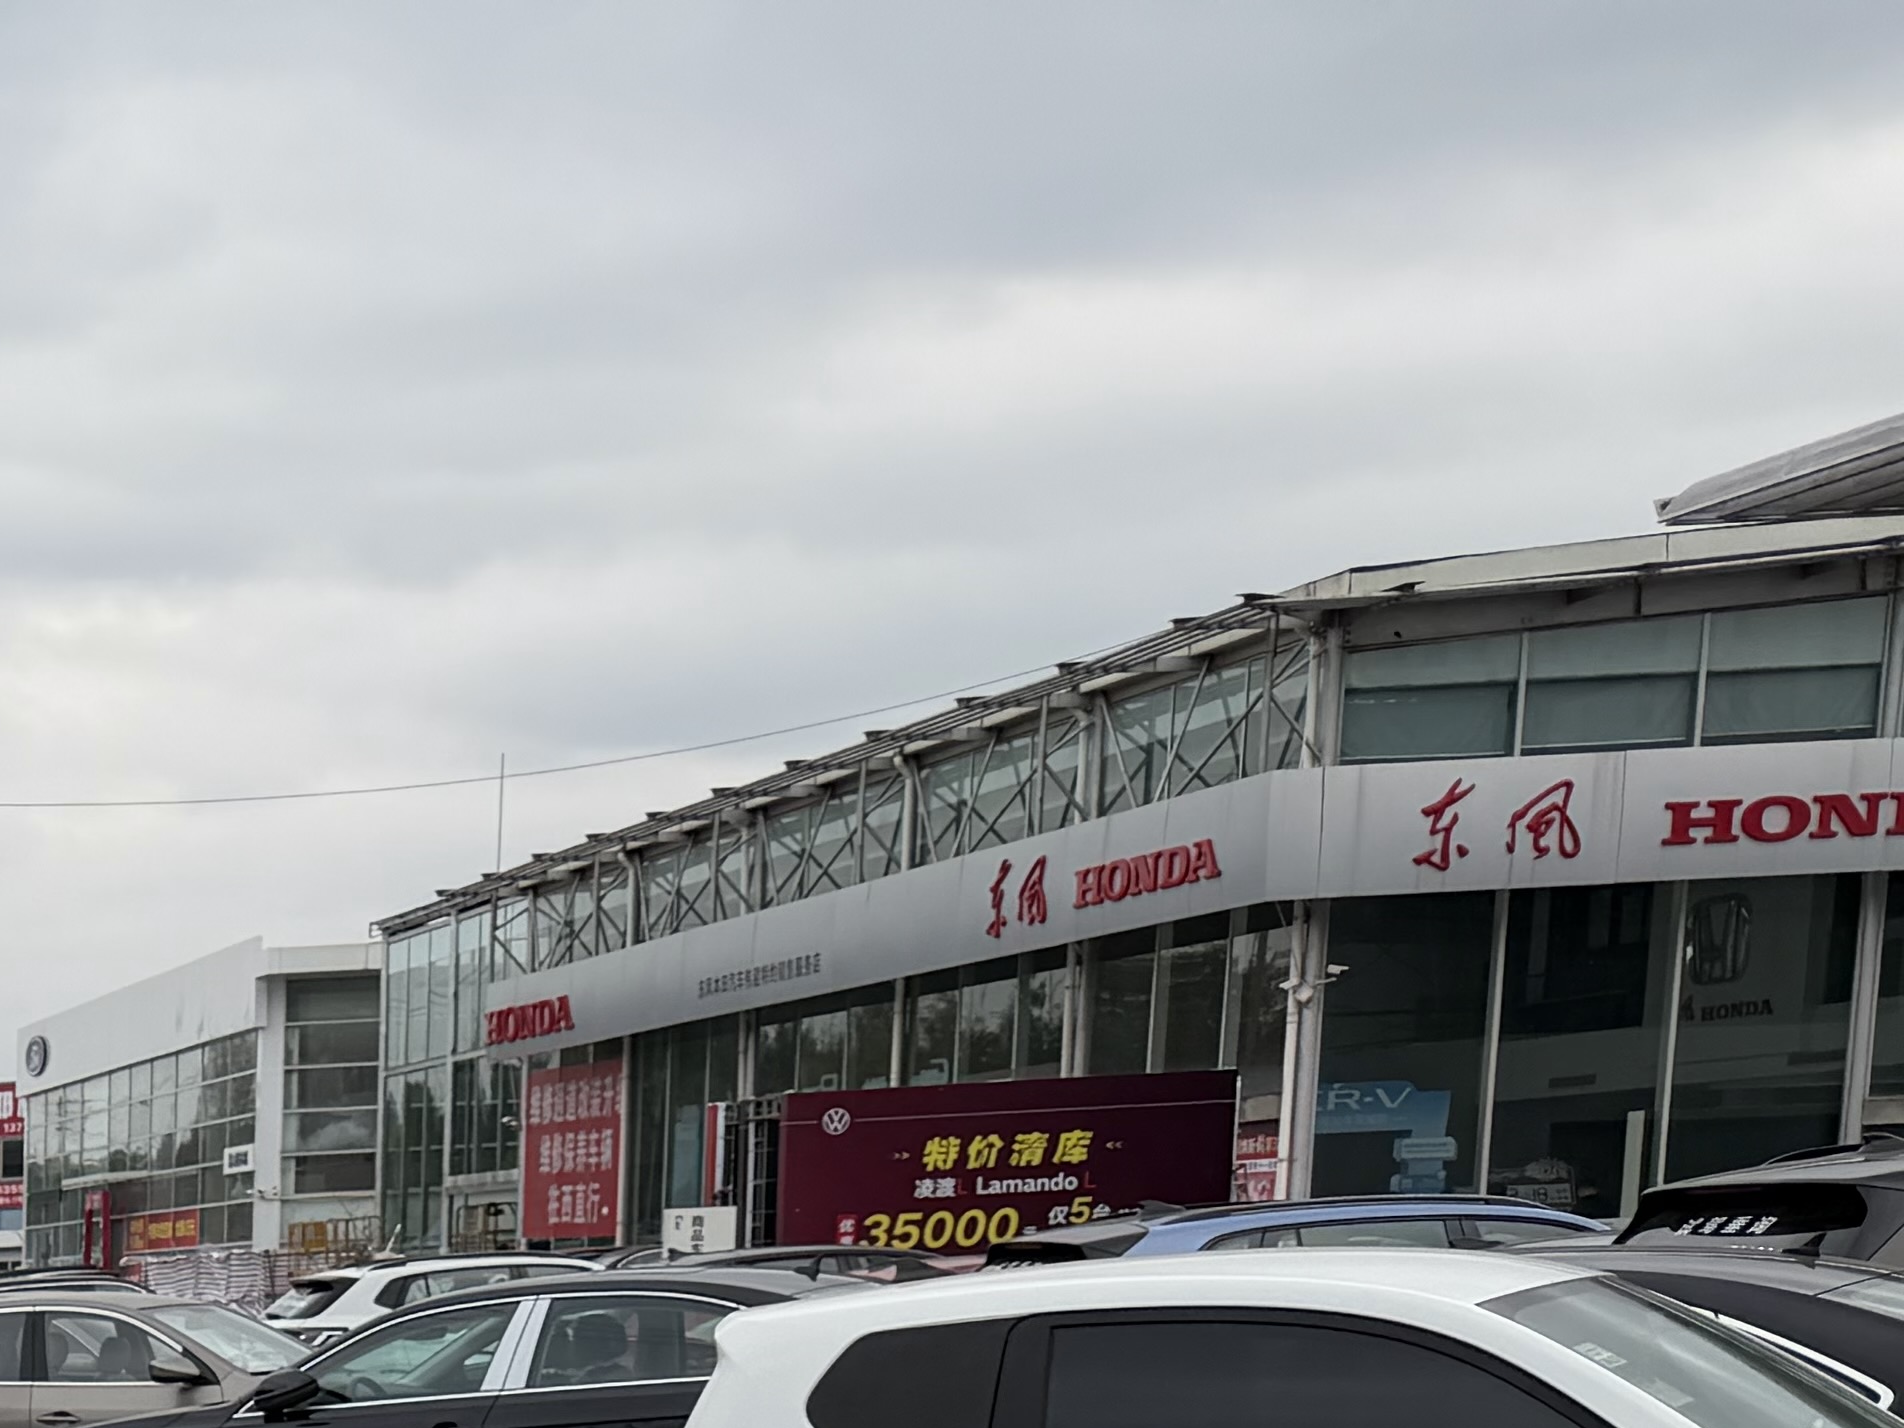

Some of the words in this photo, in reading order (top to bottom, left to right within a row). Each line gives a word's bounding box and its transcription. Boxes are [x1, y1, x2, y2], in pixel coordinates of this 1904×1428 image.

[1661, 792, 1904, 846] HON
[1073, 838, 1222, 909] HONDA
[485, 995, 575, 1046] HONDA
[1701, 999, 1773, 1021] HONDA
[921, 1129, 1094, 1172] 特价清库
[976, 1173, 1078, 1195] Lamando
[860, 1207, 1019, 1249] 35000
